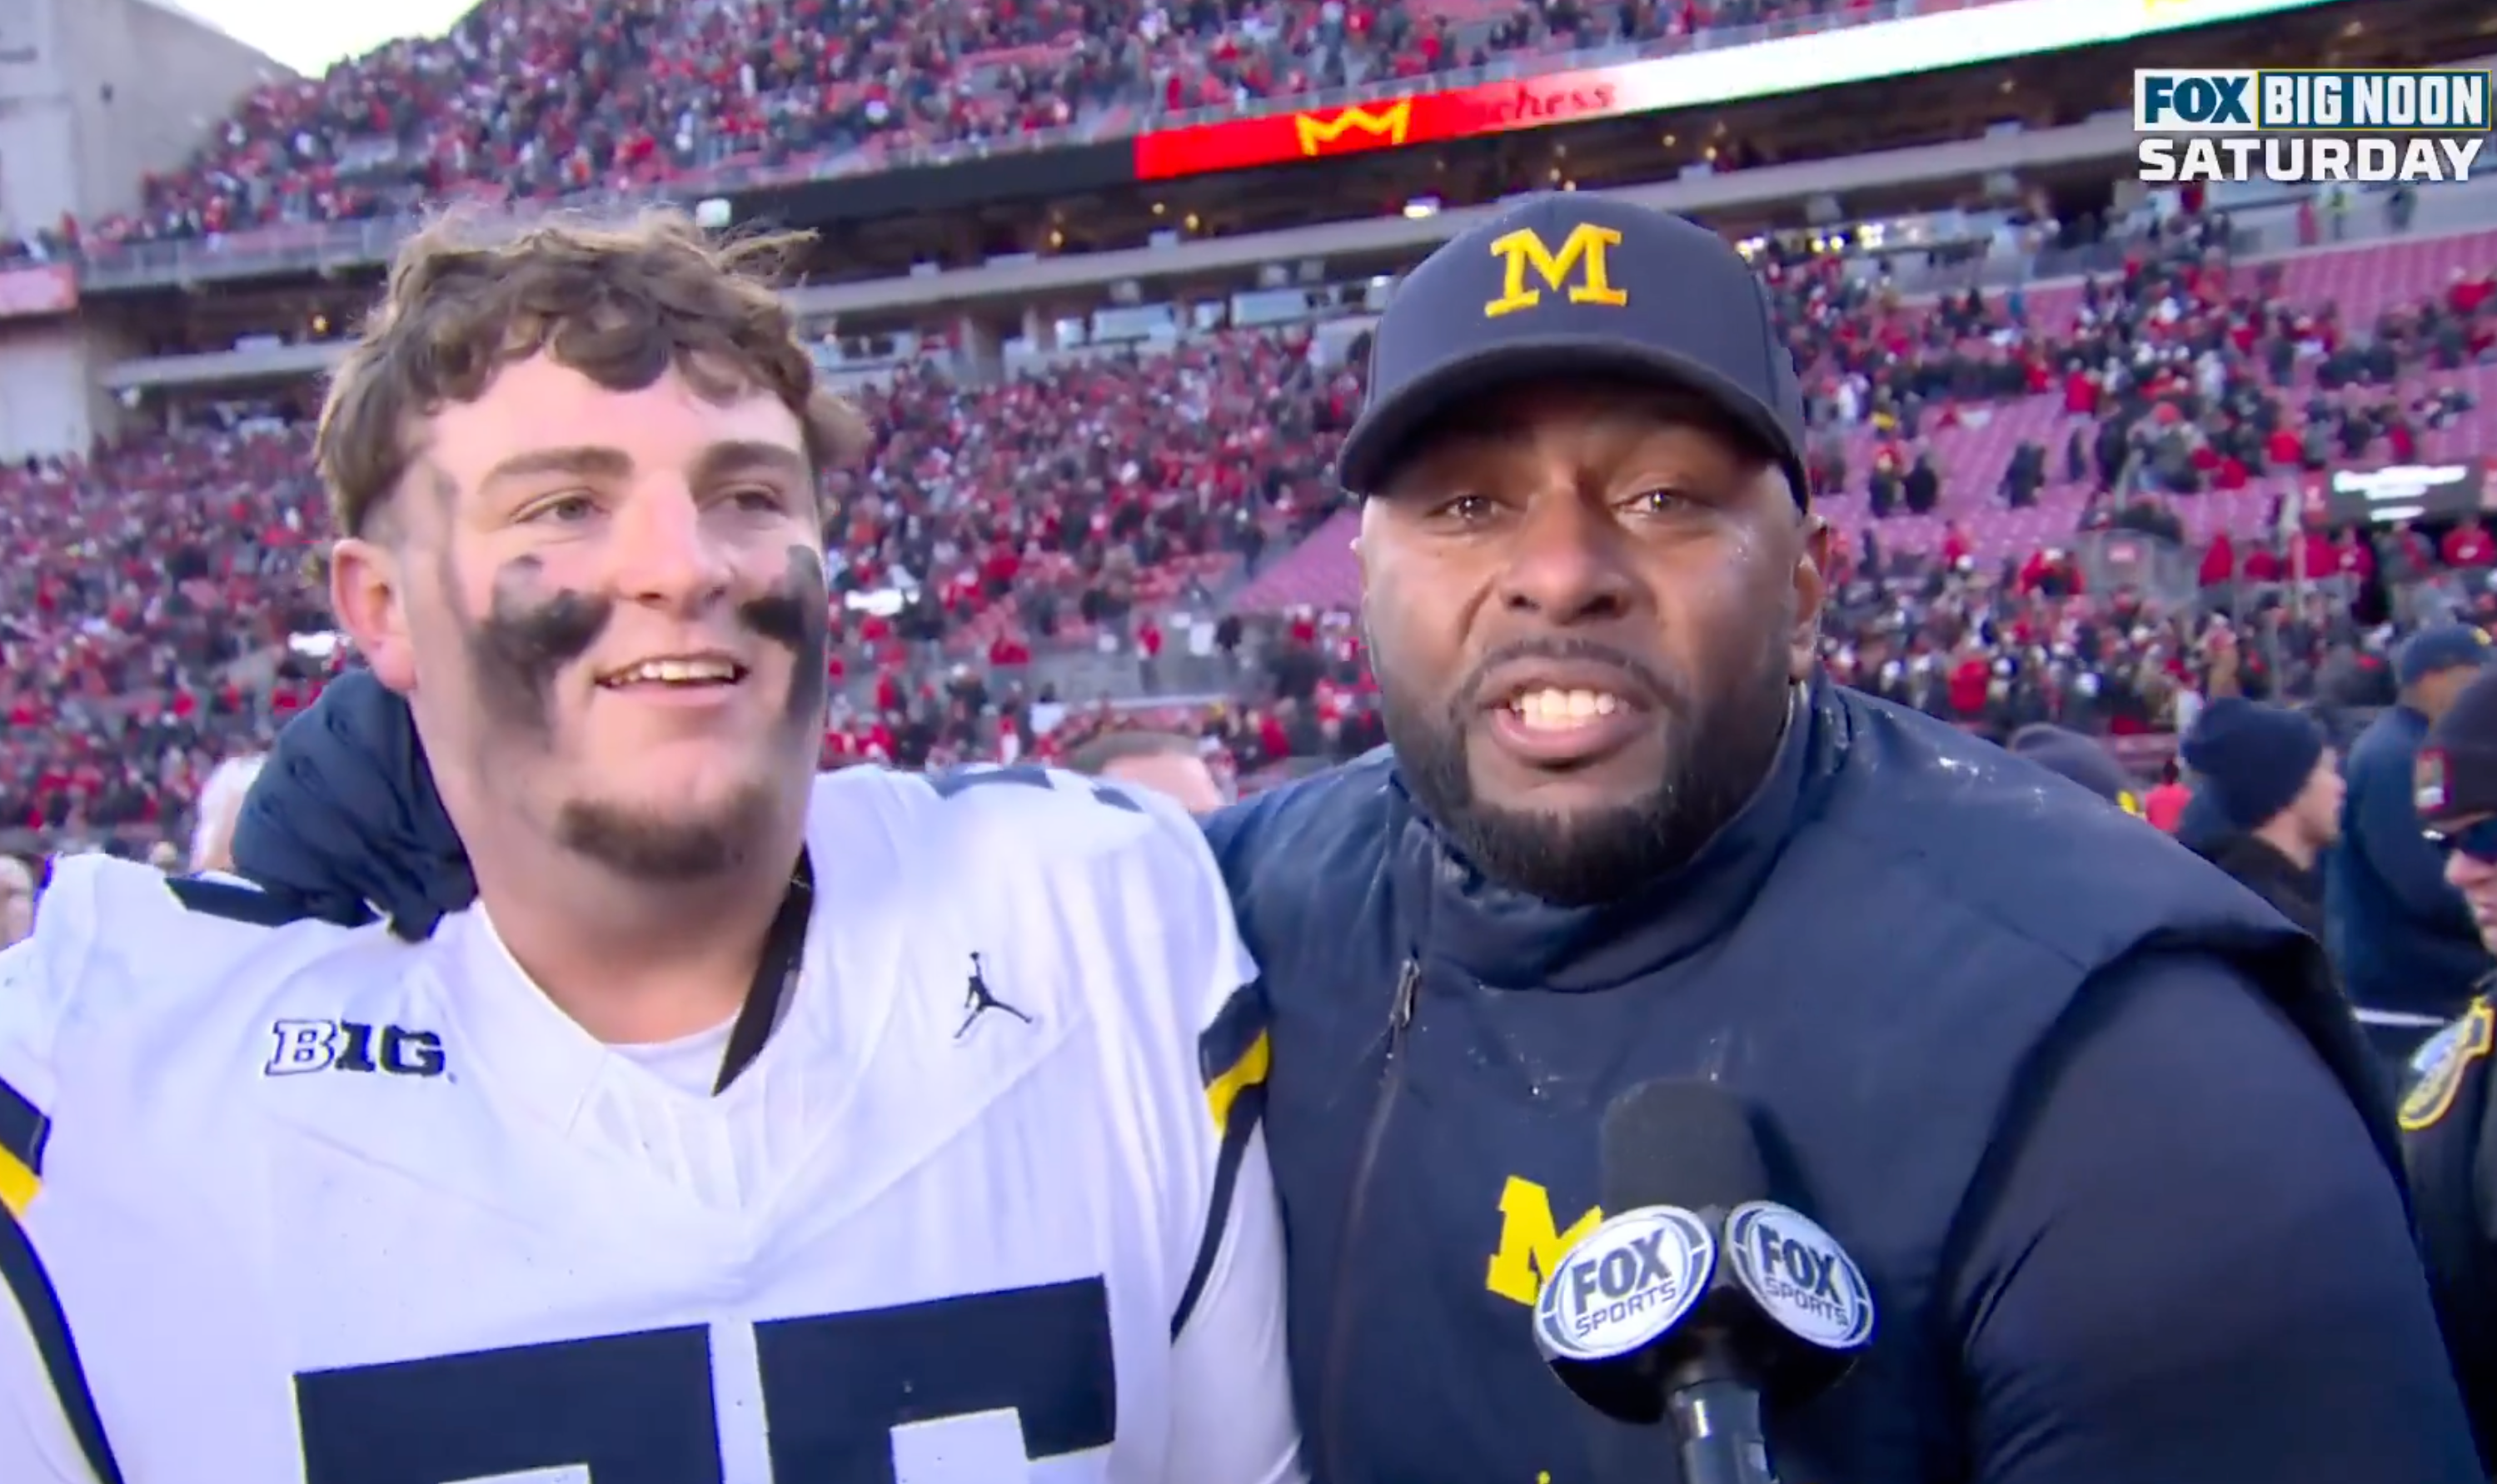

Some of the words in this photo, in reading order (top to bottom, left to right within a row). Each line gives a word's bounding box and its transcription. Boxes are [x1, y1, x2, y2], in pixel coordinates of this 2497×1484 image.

[1484, 222, 1627, 317] M
[1571, 1228, 1672, 1314] FOX
[1757, 1223, 1841, 1306] FOX
[1764, 1277, 1849, 1327] SPORTS
[1575, 1279, 1677, 1338] SPORTS
